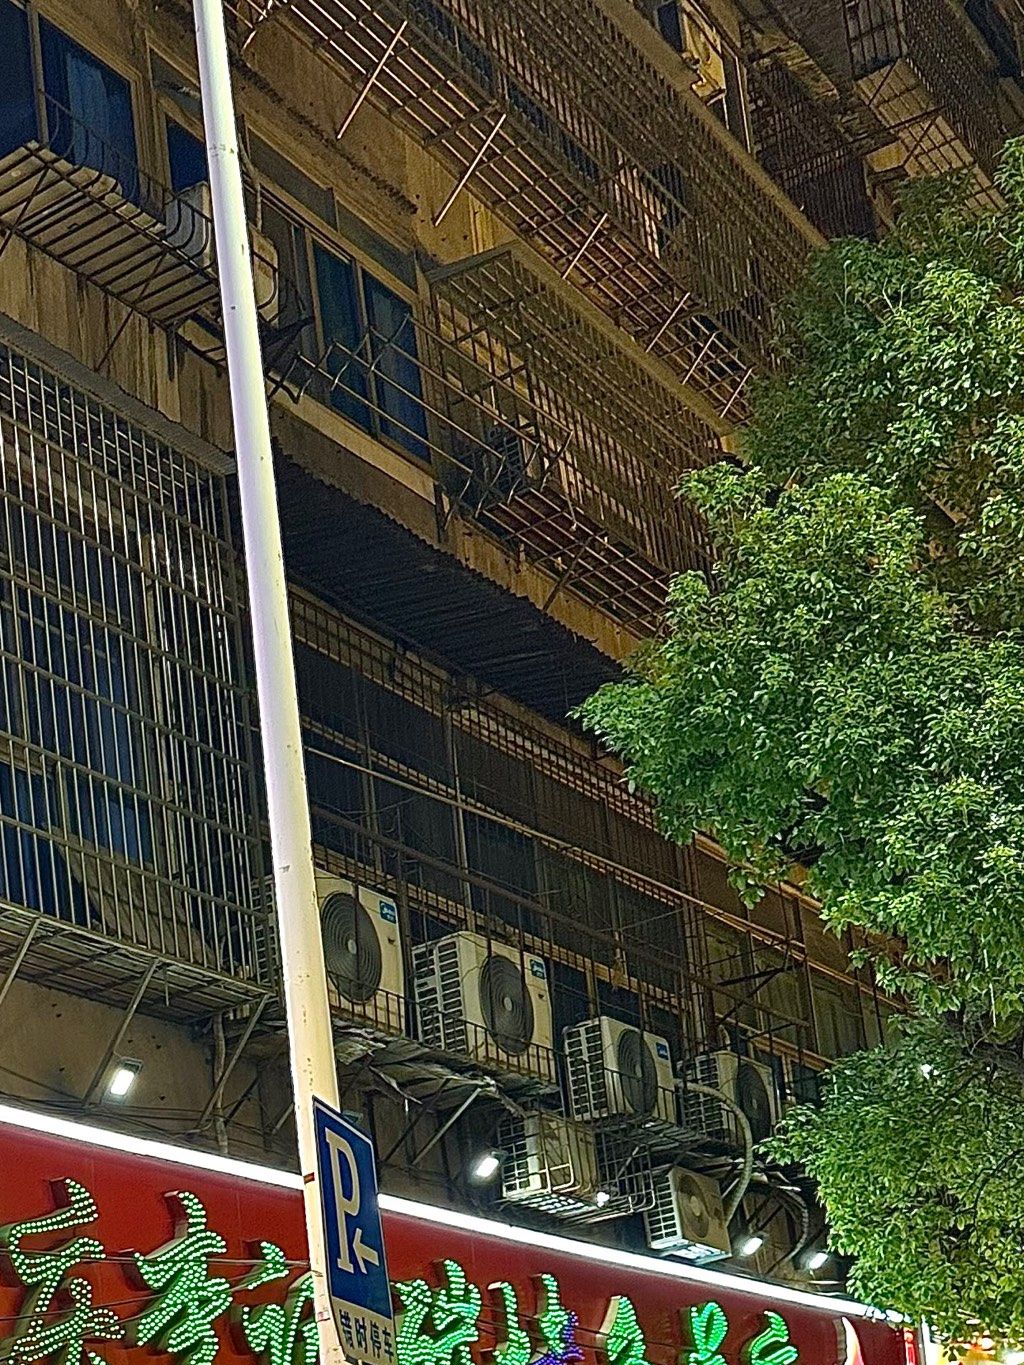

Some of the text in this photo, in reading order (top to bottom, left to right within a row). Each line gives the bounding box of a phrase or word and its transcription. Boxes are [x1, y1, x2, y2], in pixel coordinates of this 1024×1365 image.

[324, 1125, 361, 1274] P
[338, 1307, 395, 1364] 错时停车
